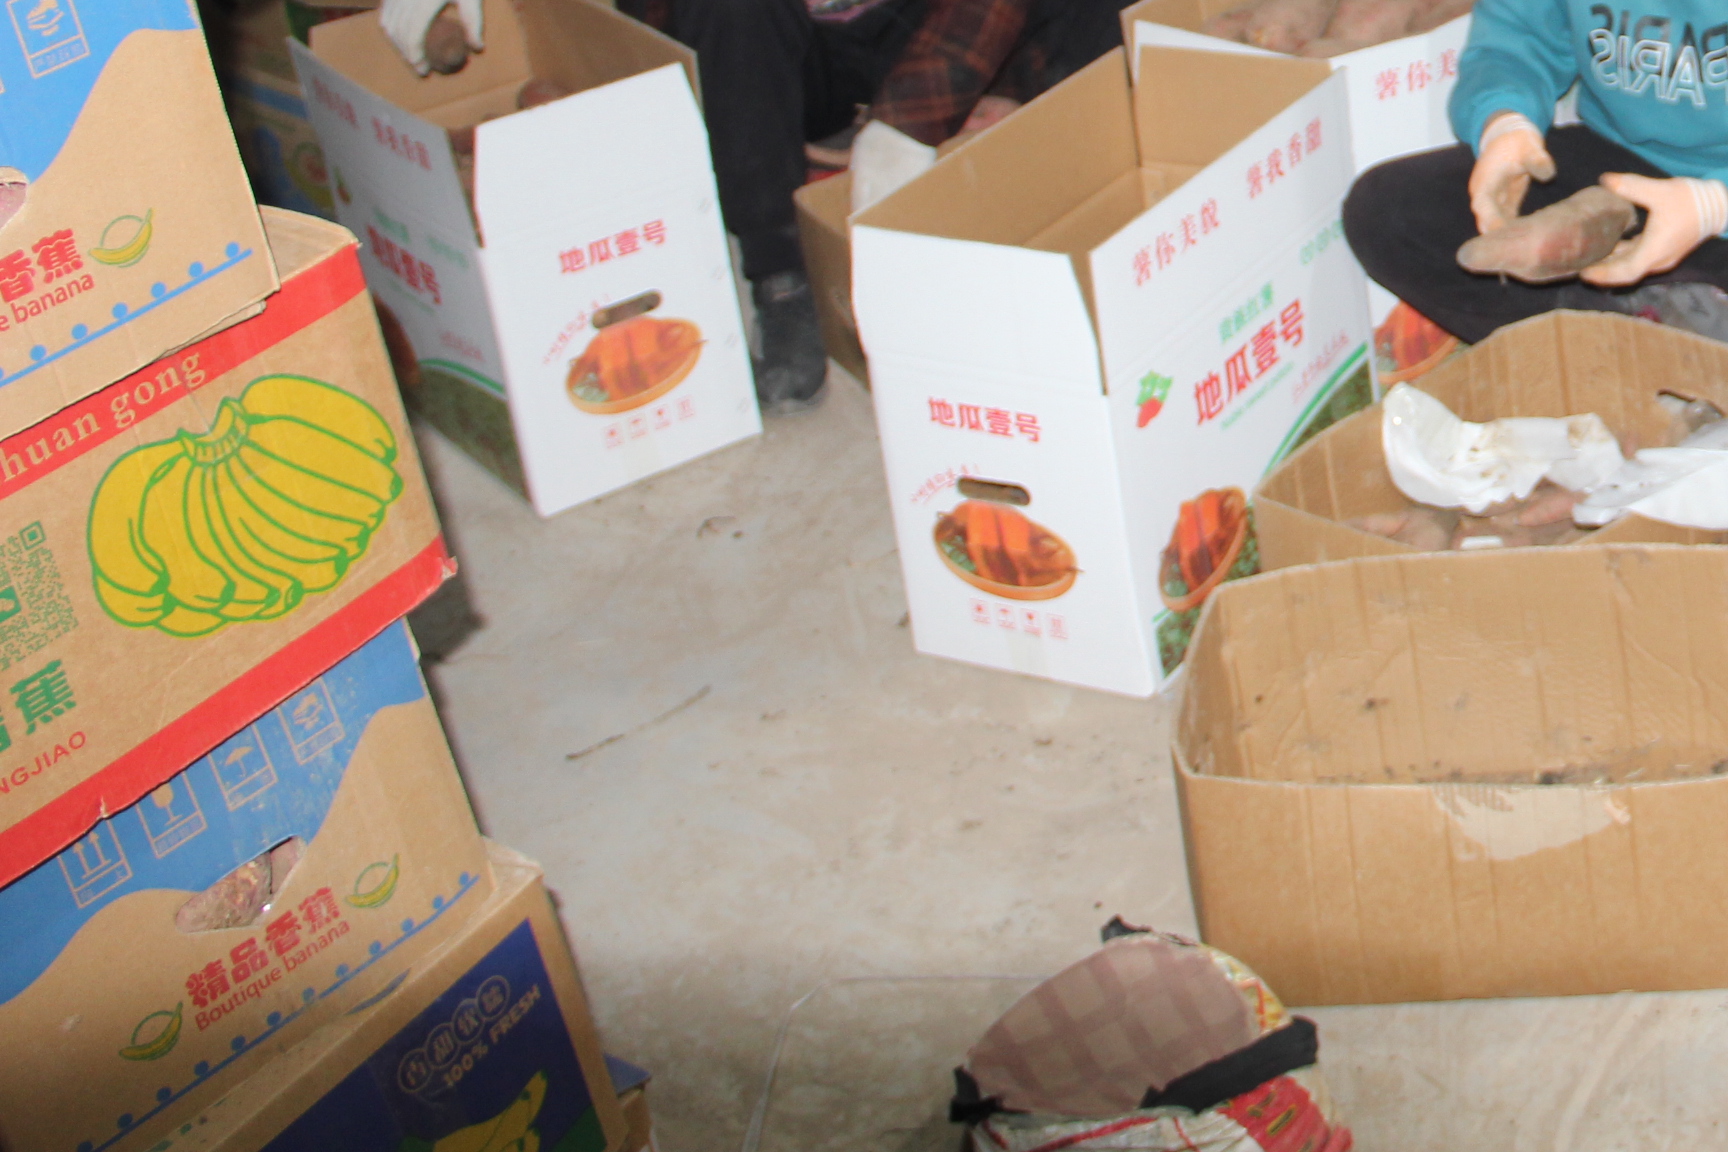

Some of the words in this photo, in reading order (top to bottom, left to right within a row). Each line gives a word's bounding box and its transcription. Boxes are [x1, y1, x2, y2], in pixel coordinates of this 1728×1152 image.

[558, 218, 668, 275] 地瓜壹号
[11, 271, 95, 324] banana
[109, 350, 207, 431] gong
[1192, 297, 1306, 427] 地瓜壹号
[927, 396, 1043, 443] 地瓜壹号
[0, 658, 78, 750] 蕉
[183, 885, 344, 1010] 精品香蕉
[193, 964, 283, 1033] Boutique
[282, 918, 352, 974] banana
[489, 982, 542, 1045] FRESH
